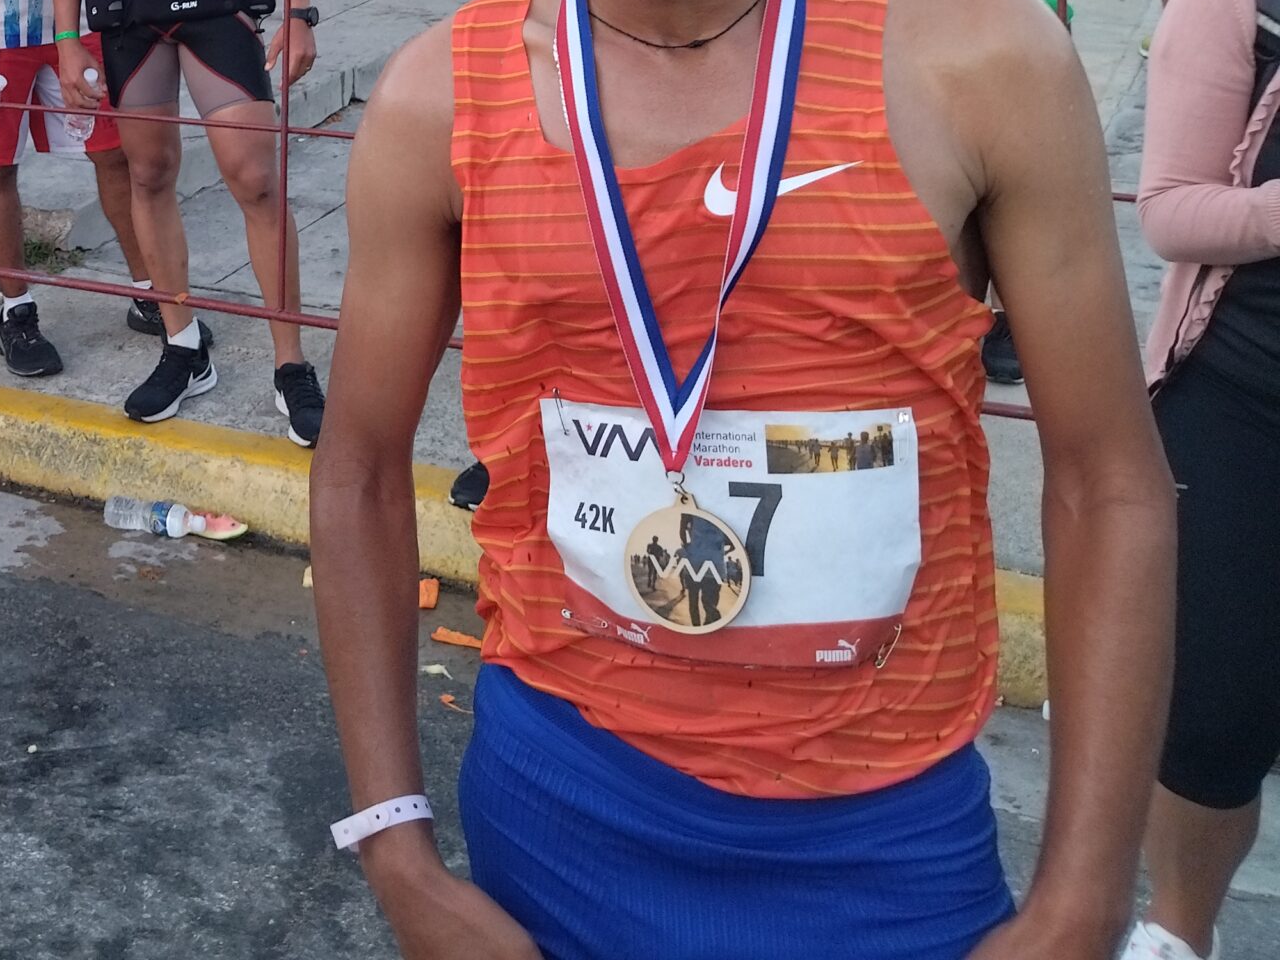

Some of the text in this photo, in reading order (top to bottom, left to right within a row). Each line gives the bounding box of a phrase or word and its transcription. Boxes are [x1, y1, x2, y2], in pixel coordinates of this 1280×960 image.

[693, 443, 741, 455] Marathon
[694, 456, 753, 469] Varadero
[574, 502, 616, 535] 42K
[816, 650, 852, 663] PUMA
